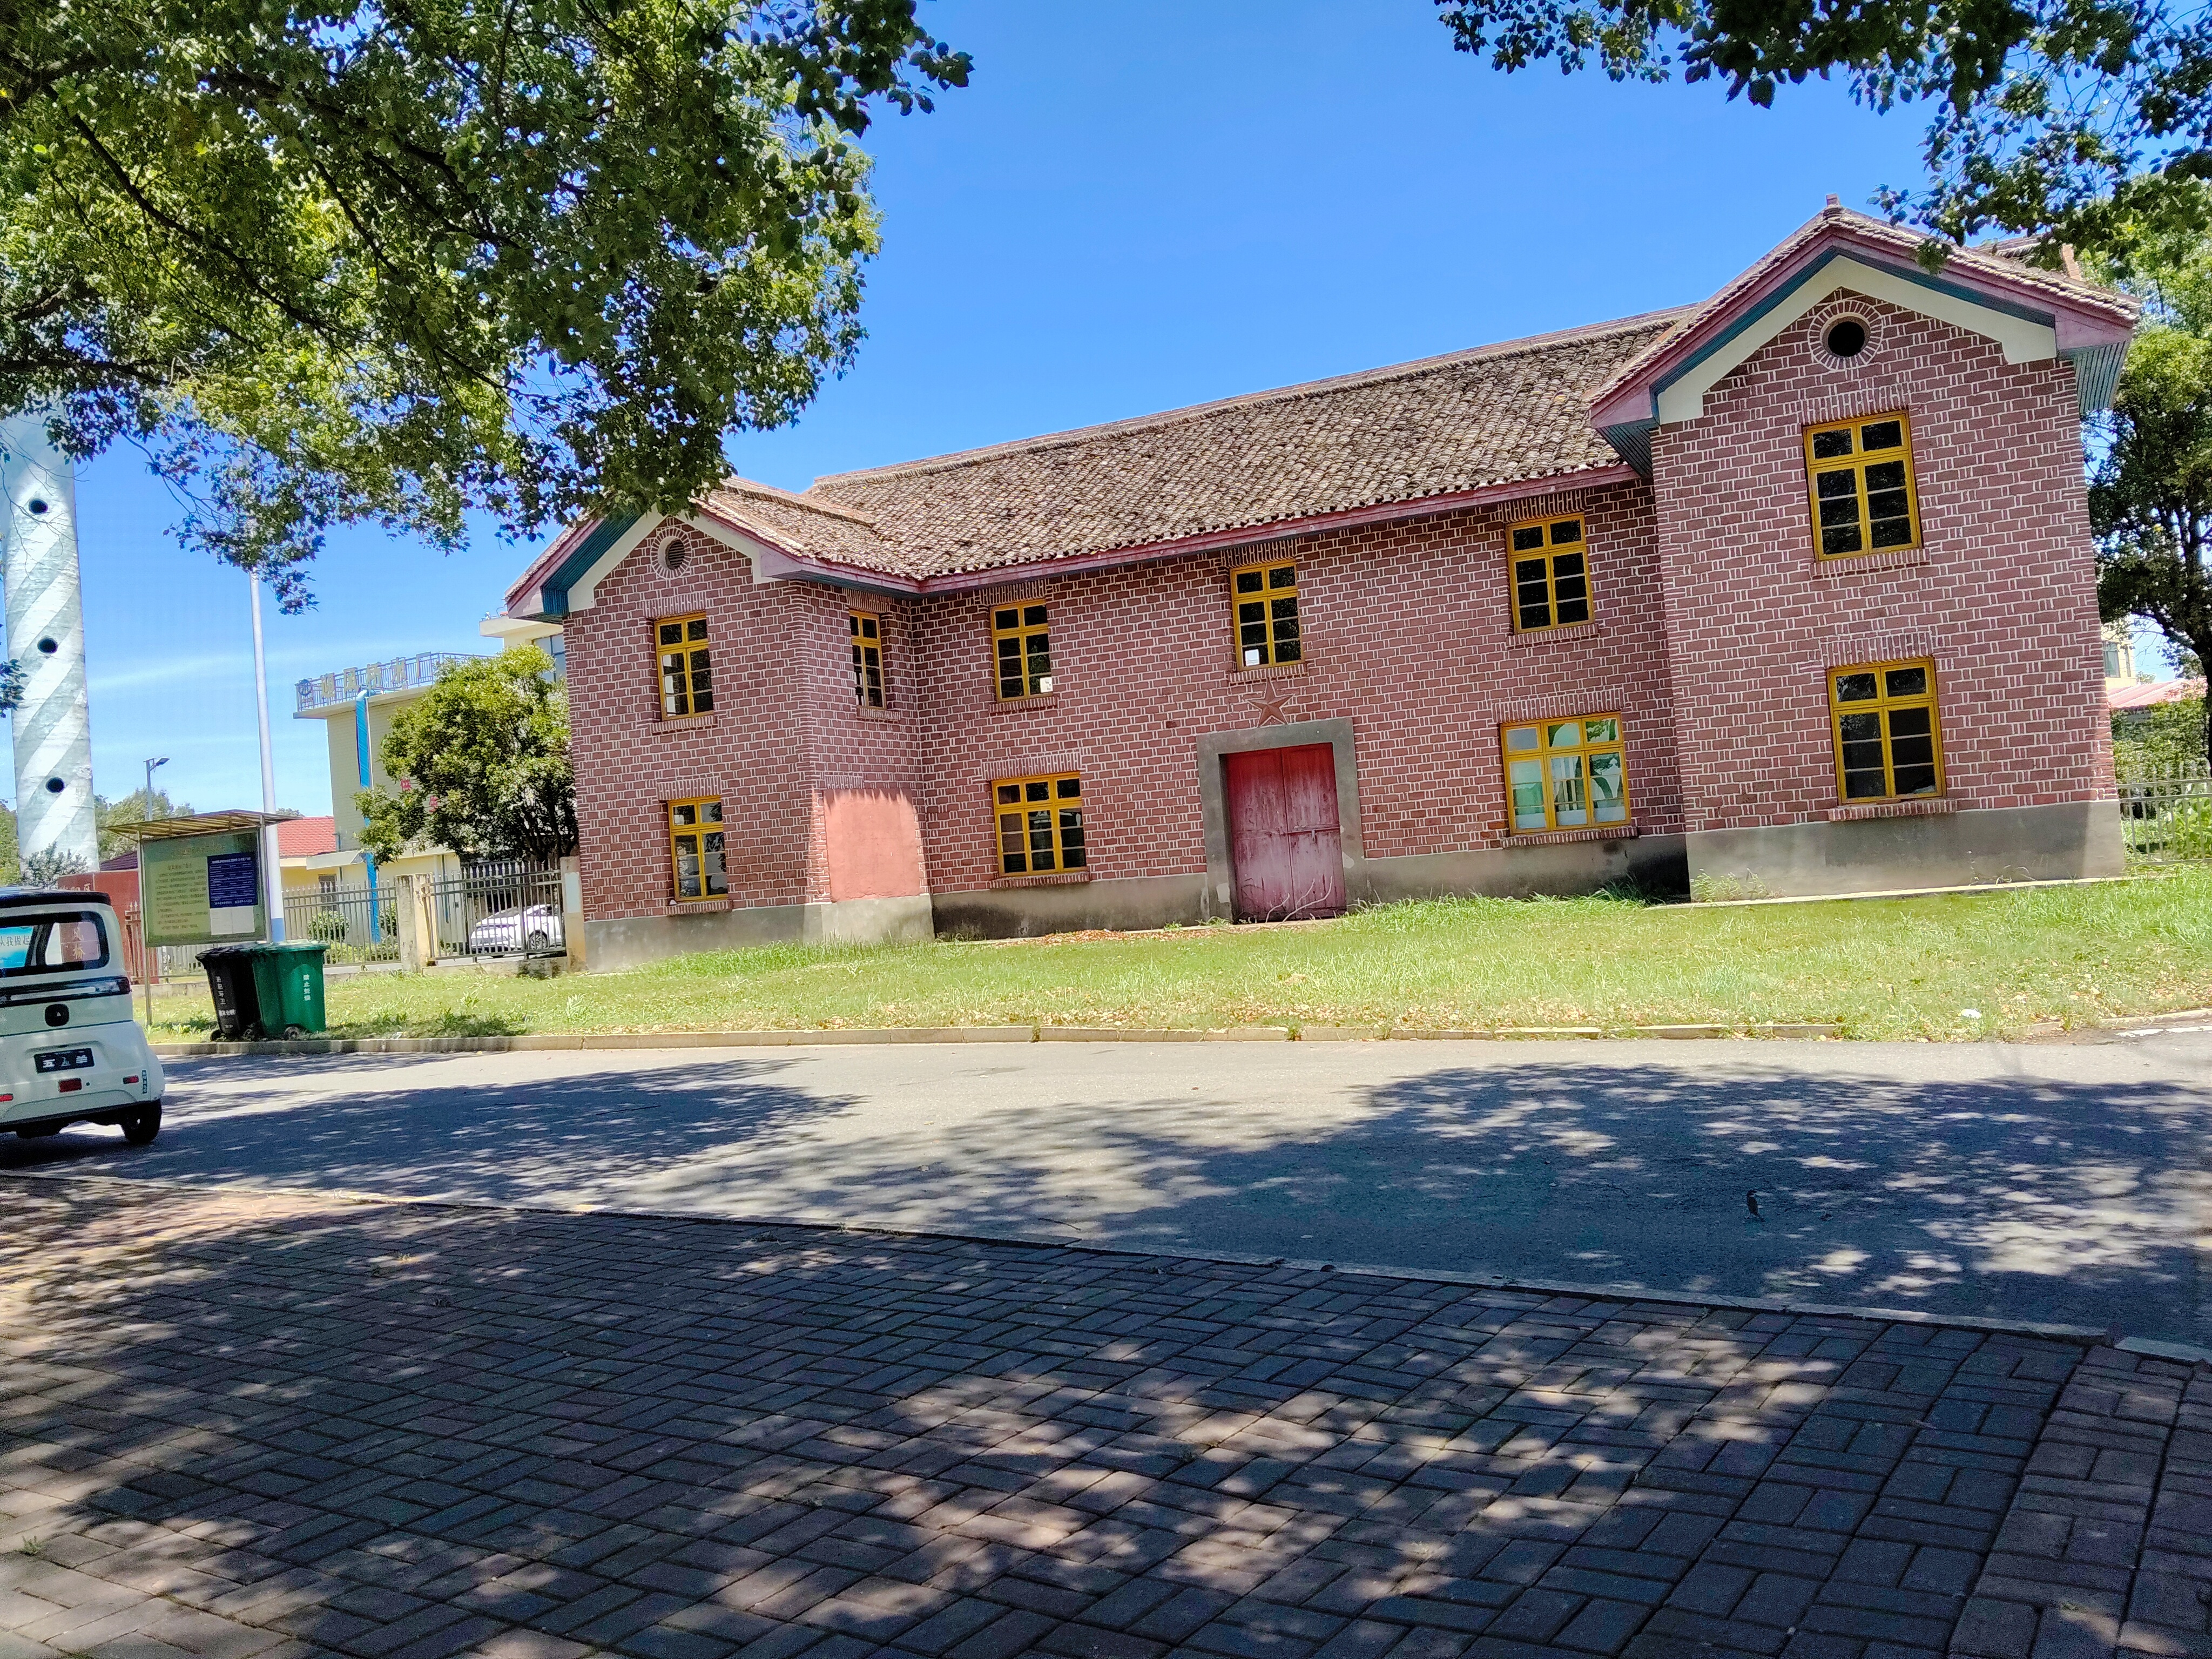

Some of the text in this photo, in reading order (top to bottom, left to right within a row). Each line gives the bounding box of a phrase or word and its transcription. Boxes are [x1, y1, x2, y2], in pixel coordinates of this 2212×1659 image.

[320, 651, 431, 698] 迎风桥水厂
